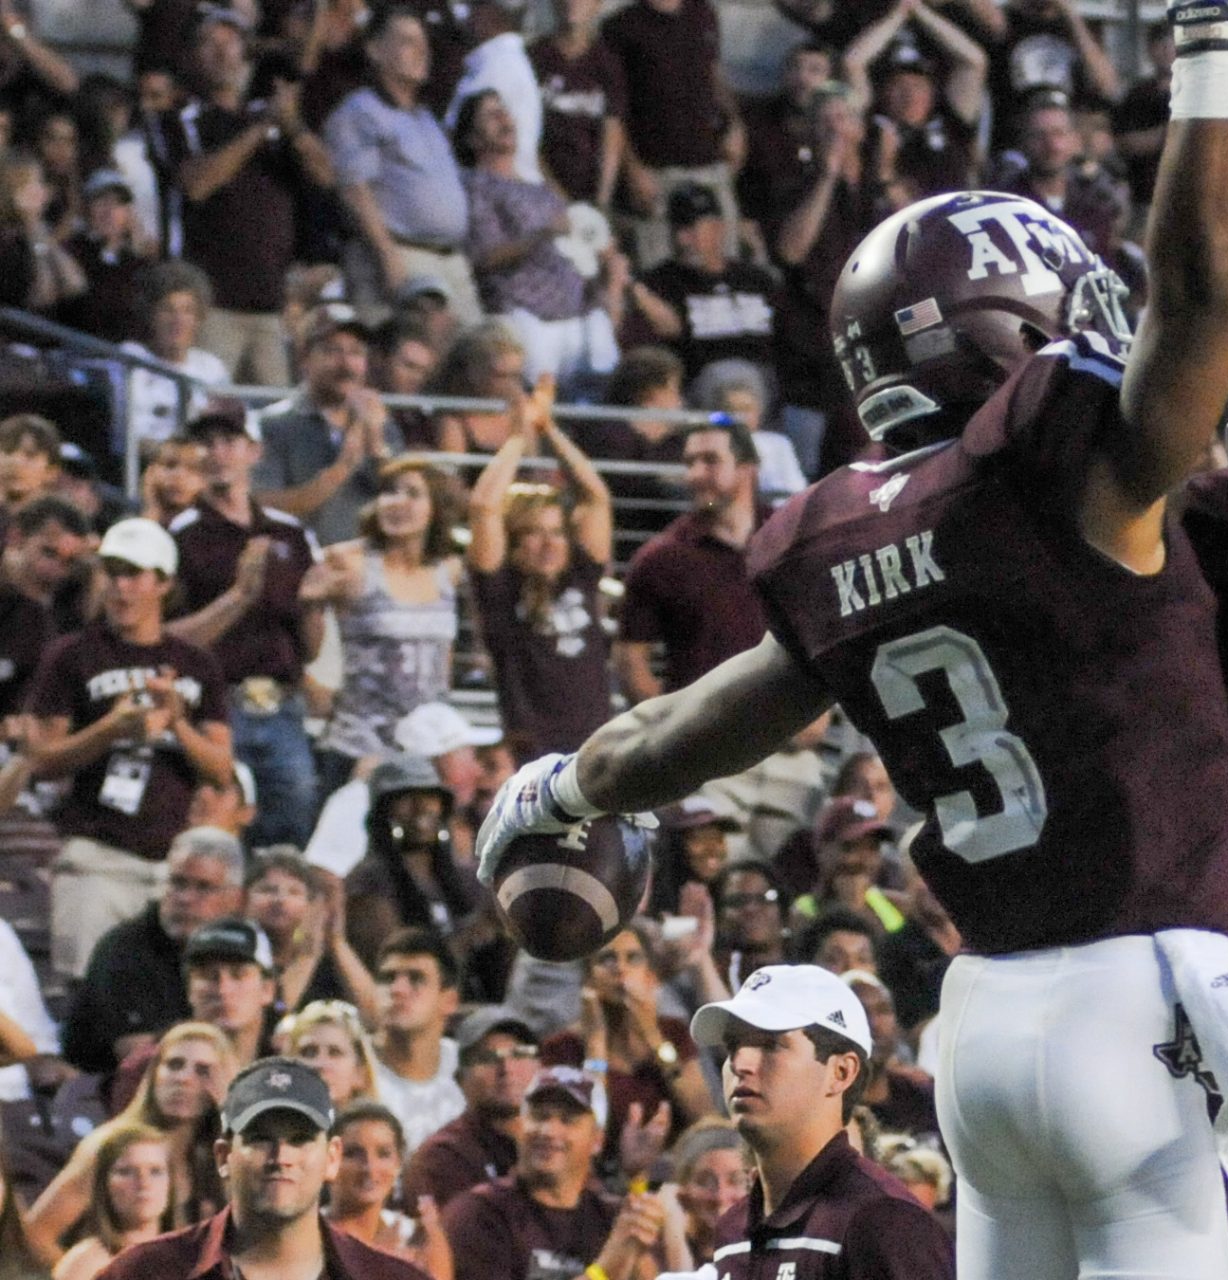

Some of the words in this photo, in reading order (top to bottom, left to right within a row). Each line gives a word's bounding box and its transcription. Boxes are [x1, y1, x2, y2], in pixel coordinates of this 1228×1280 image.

[1176, 6, 1221, 21] adizero
[830, 529, 946, 618] KIRK
[870, 624, 1048, 865] 3
